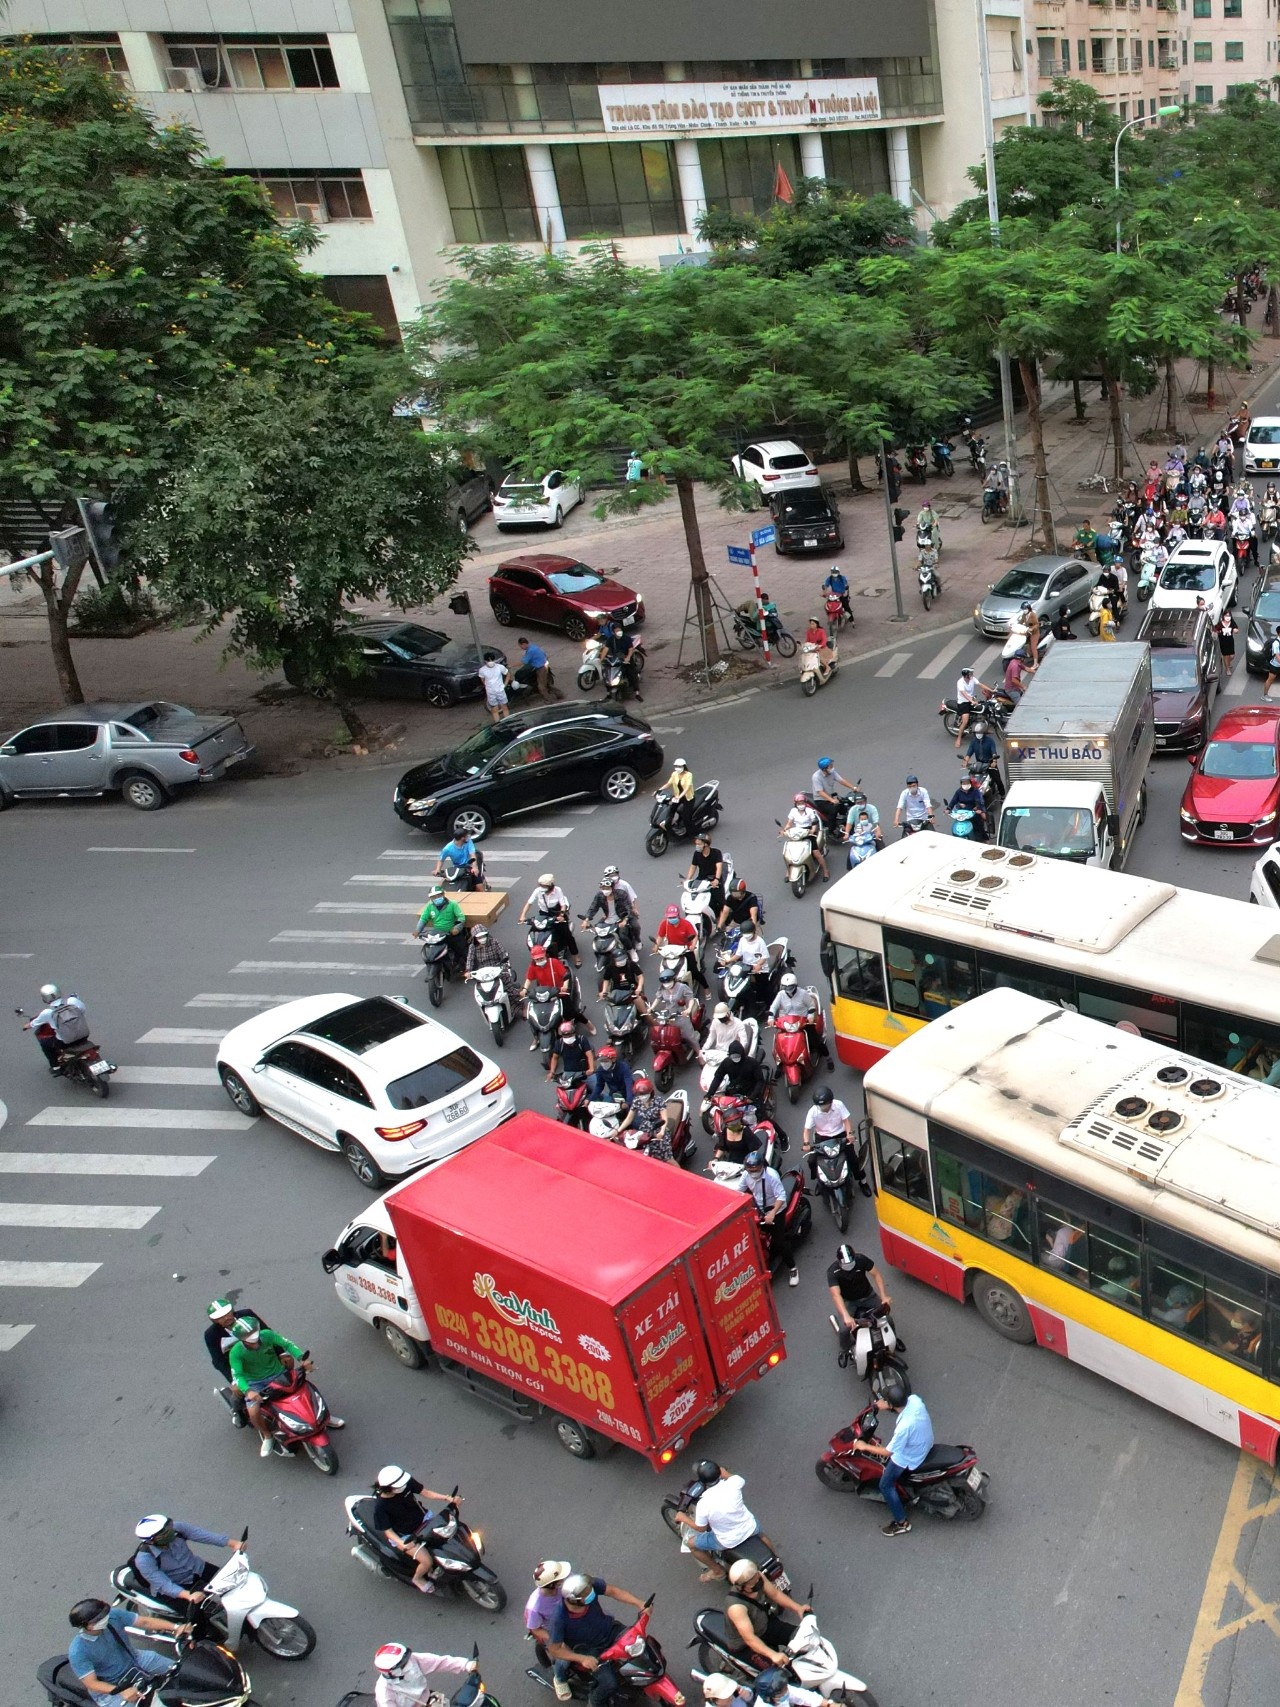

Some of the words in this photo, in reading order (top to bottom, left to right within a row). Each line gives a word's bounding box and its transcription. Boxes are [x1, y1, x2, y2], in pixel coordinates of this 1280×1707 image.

[606, 103, 651, 122] TRUNG
[652, 99, 680, 120] TÂM
[682, 98, 708, 120] ĐÀO
[710, 101, 734, 122] TẠO
[736, 100, 766, 118] CNTT
[768, 100, 778, 116] &
[818, 93, 850, 114] THÔNG
[851, 92, 864, 112] HÀ
[864, 90, 878, 113] NỘI
[1018, 748, 1036, 760] XE
[1072, 744, 1102, 760] BÁO
[707, 1248, 730, 1280] GIÁ
[733, 1232, 750, 1259] RẺ
[359, 1276, 396, 1304] 3388.3388
[634, 1314, 654, 1341] XE
[656, 1291, 680, 1320] TẢI
[529, 1322, 563, 1344] Express
[585, 1342, 601, 1356] 200
[726, 1320, 771, 1368] 29H-758.93
[434, 1303, 470, 1340] (024)
[472, 1311, 615, 1410] 3388.3388
[446, 1338, 468, 1356] DỌN
[470, 1350, 492, 1368] NHÀ
[494, 1362, 523, 1382] TRỌN
[526, 1376, 545, 1393] GÓI
[669, 1402, 686, 1421] 200
